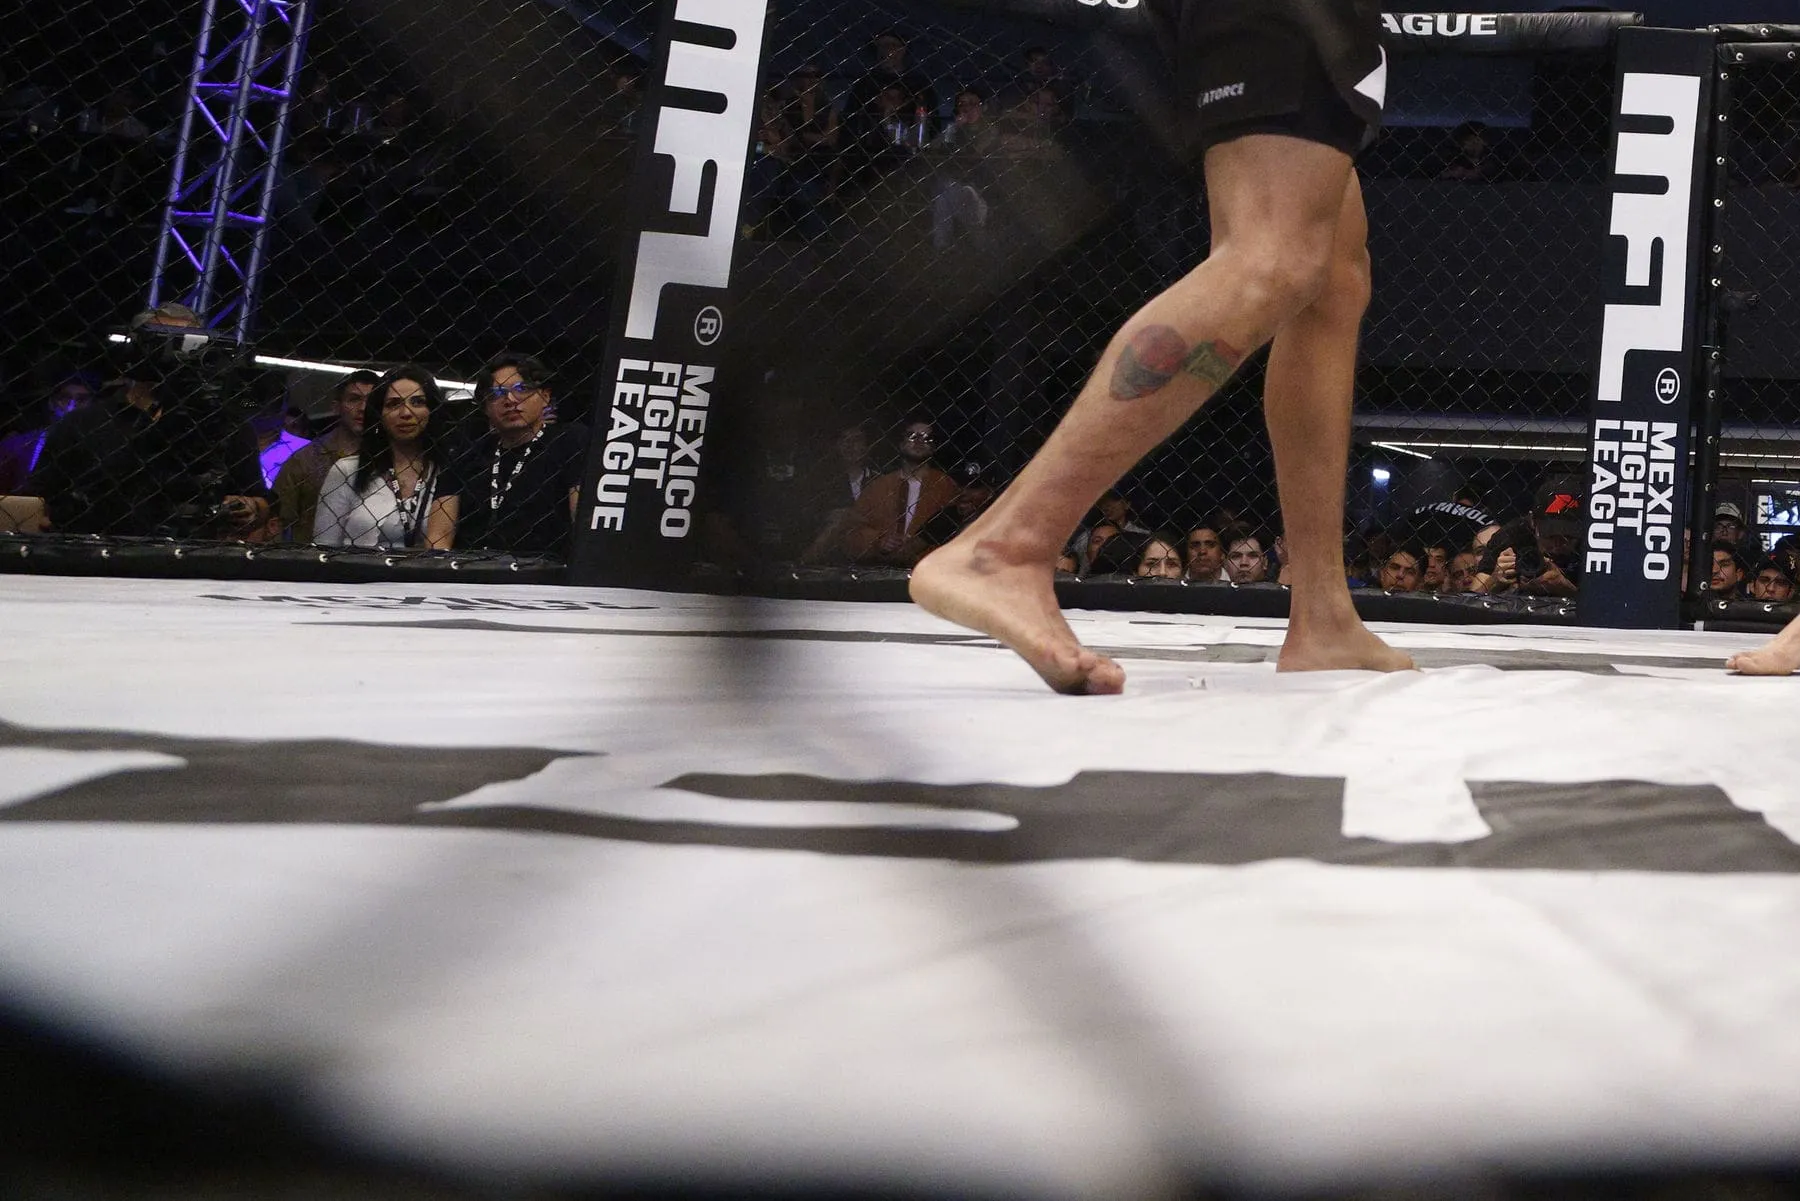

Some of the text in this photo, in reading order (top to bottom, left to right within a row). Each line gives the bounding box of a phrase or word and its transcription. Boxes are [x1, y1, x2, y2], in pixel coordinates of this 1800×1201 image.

[1597, 72, 1700, 401] MFL
[590, 357, 651, 532] LEAGUE
[635, 360, 683, 489] FIGHT
[659, 363, 716, 539] MEXICO
[1585, 418, 1622, 574] LEAGUE
[1616, 420, 1649, 536] FIGHT
[1642, 421, 1679, 581] MEXICO
